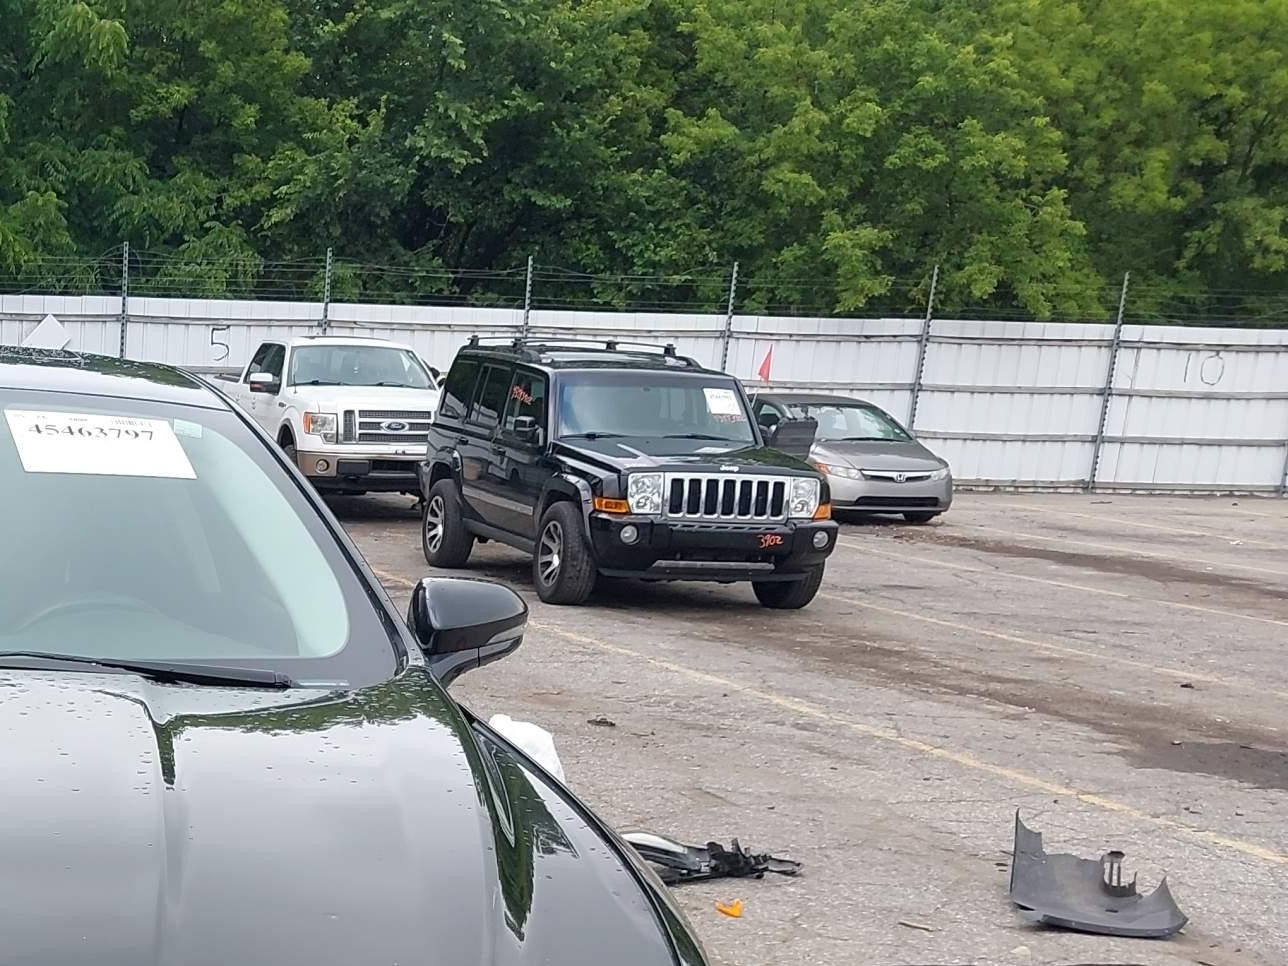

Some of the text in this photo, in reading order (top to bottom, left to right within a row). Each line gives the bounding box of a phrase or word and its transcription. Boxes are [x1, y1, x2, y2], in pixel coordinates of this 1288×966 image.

[210, 325, 231, 362] 5
[1183, 351, 1225, 386] 10
[27, 423, 154, 441] 45463797
